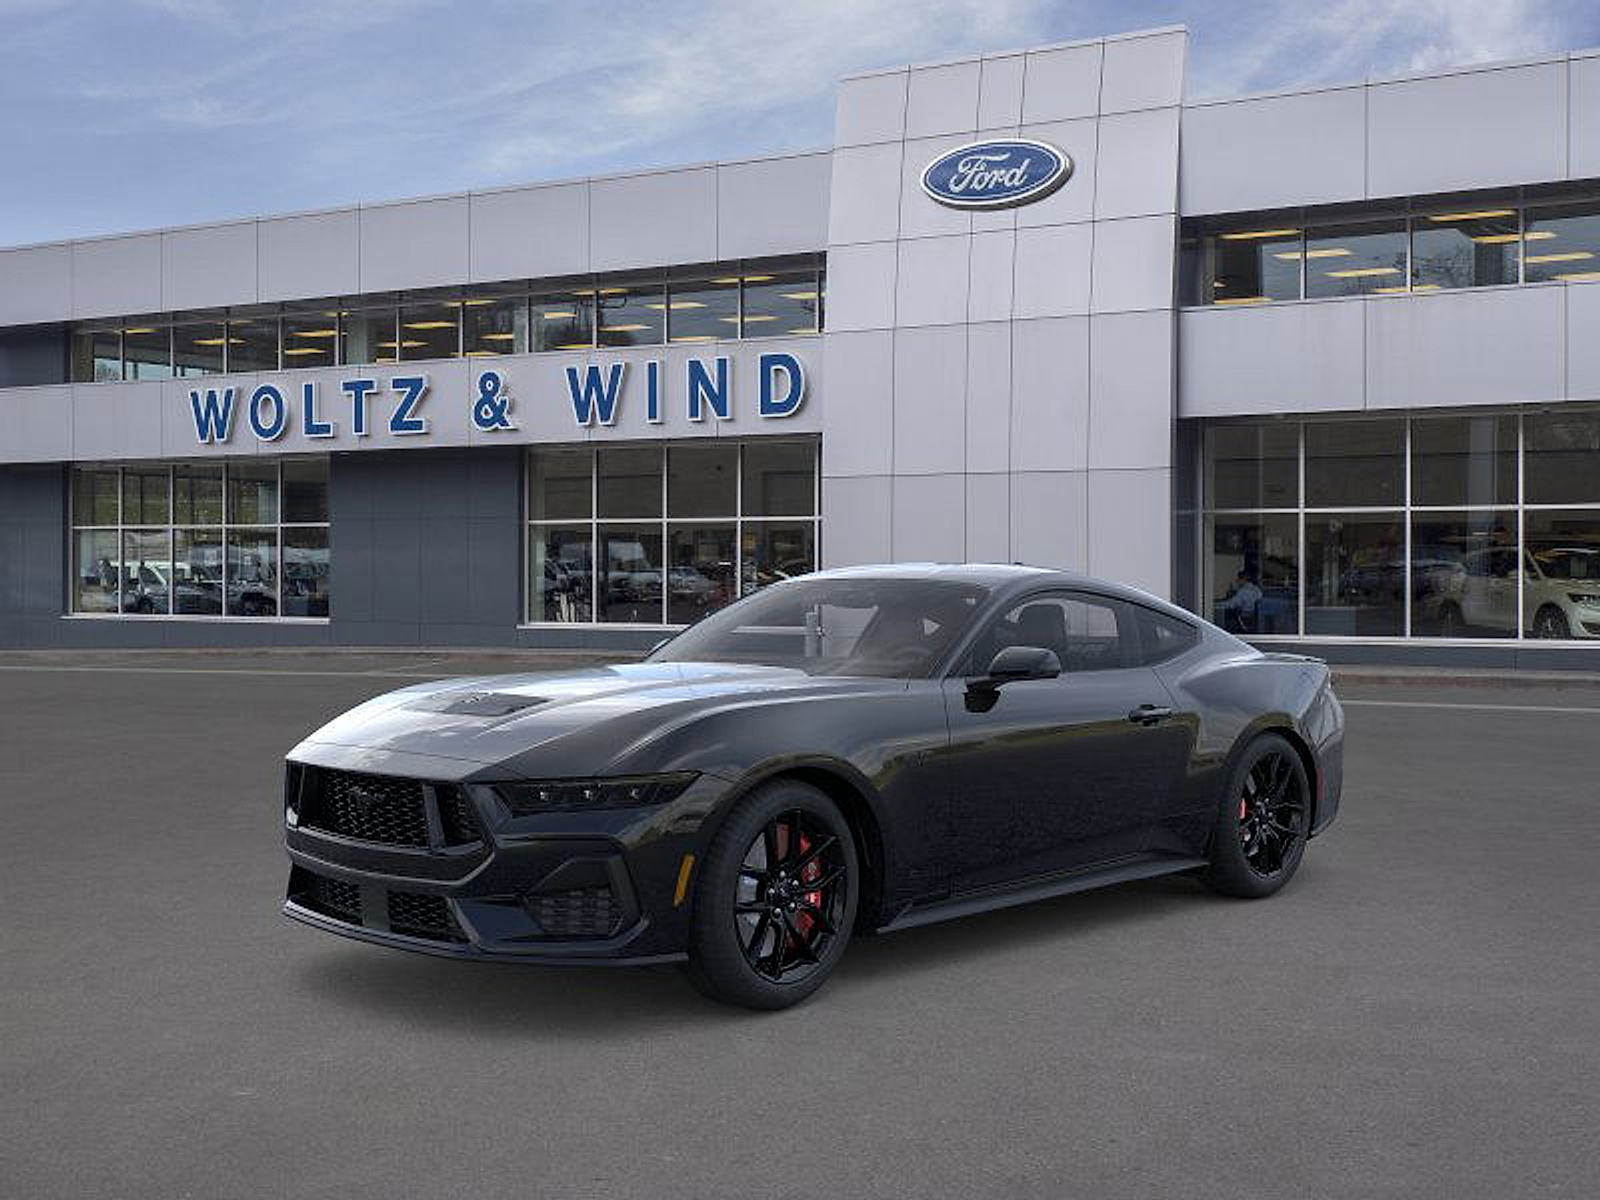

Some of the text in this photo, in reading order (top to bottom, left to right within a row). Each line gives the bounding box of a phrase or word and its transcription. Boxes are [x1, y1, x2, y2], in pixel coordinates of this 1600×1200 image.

[950, 152, 1031, 193] Ford
[189, 353, 806, 443] WOLTZ & WIND
